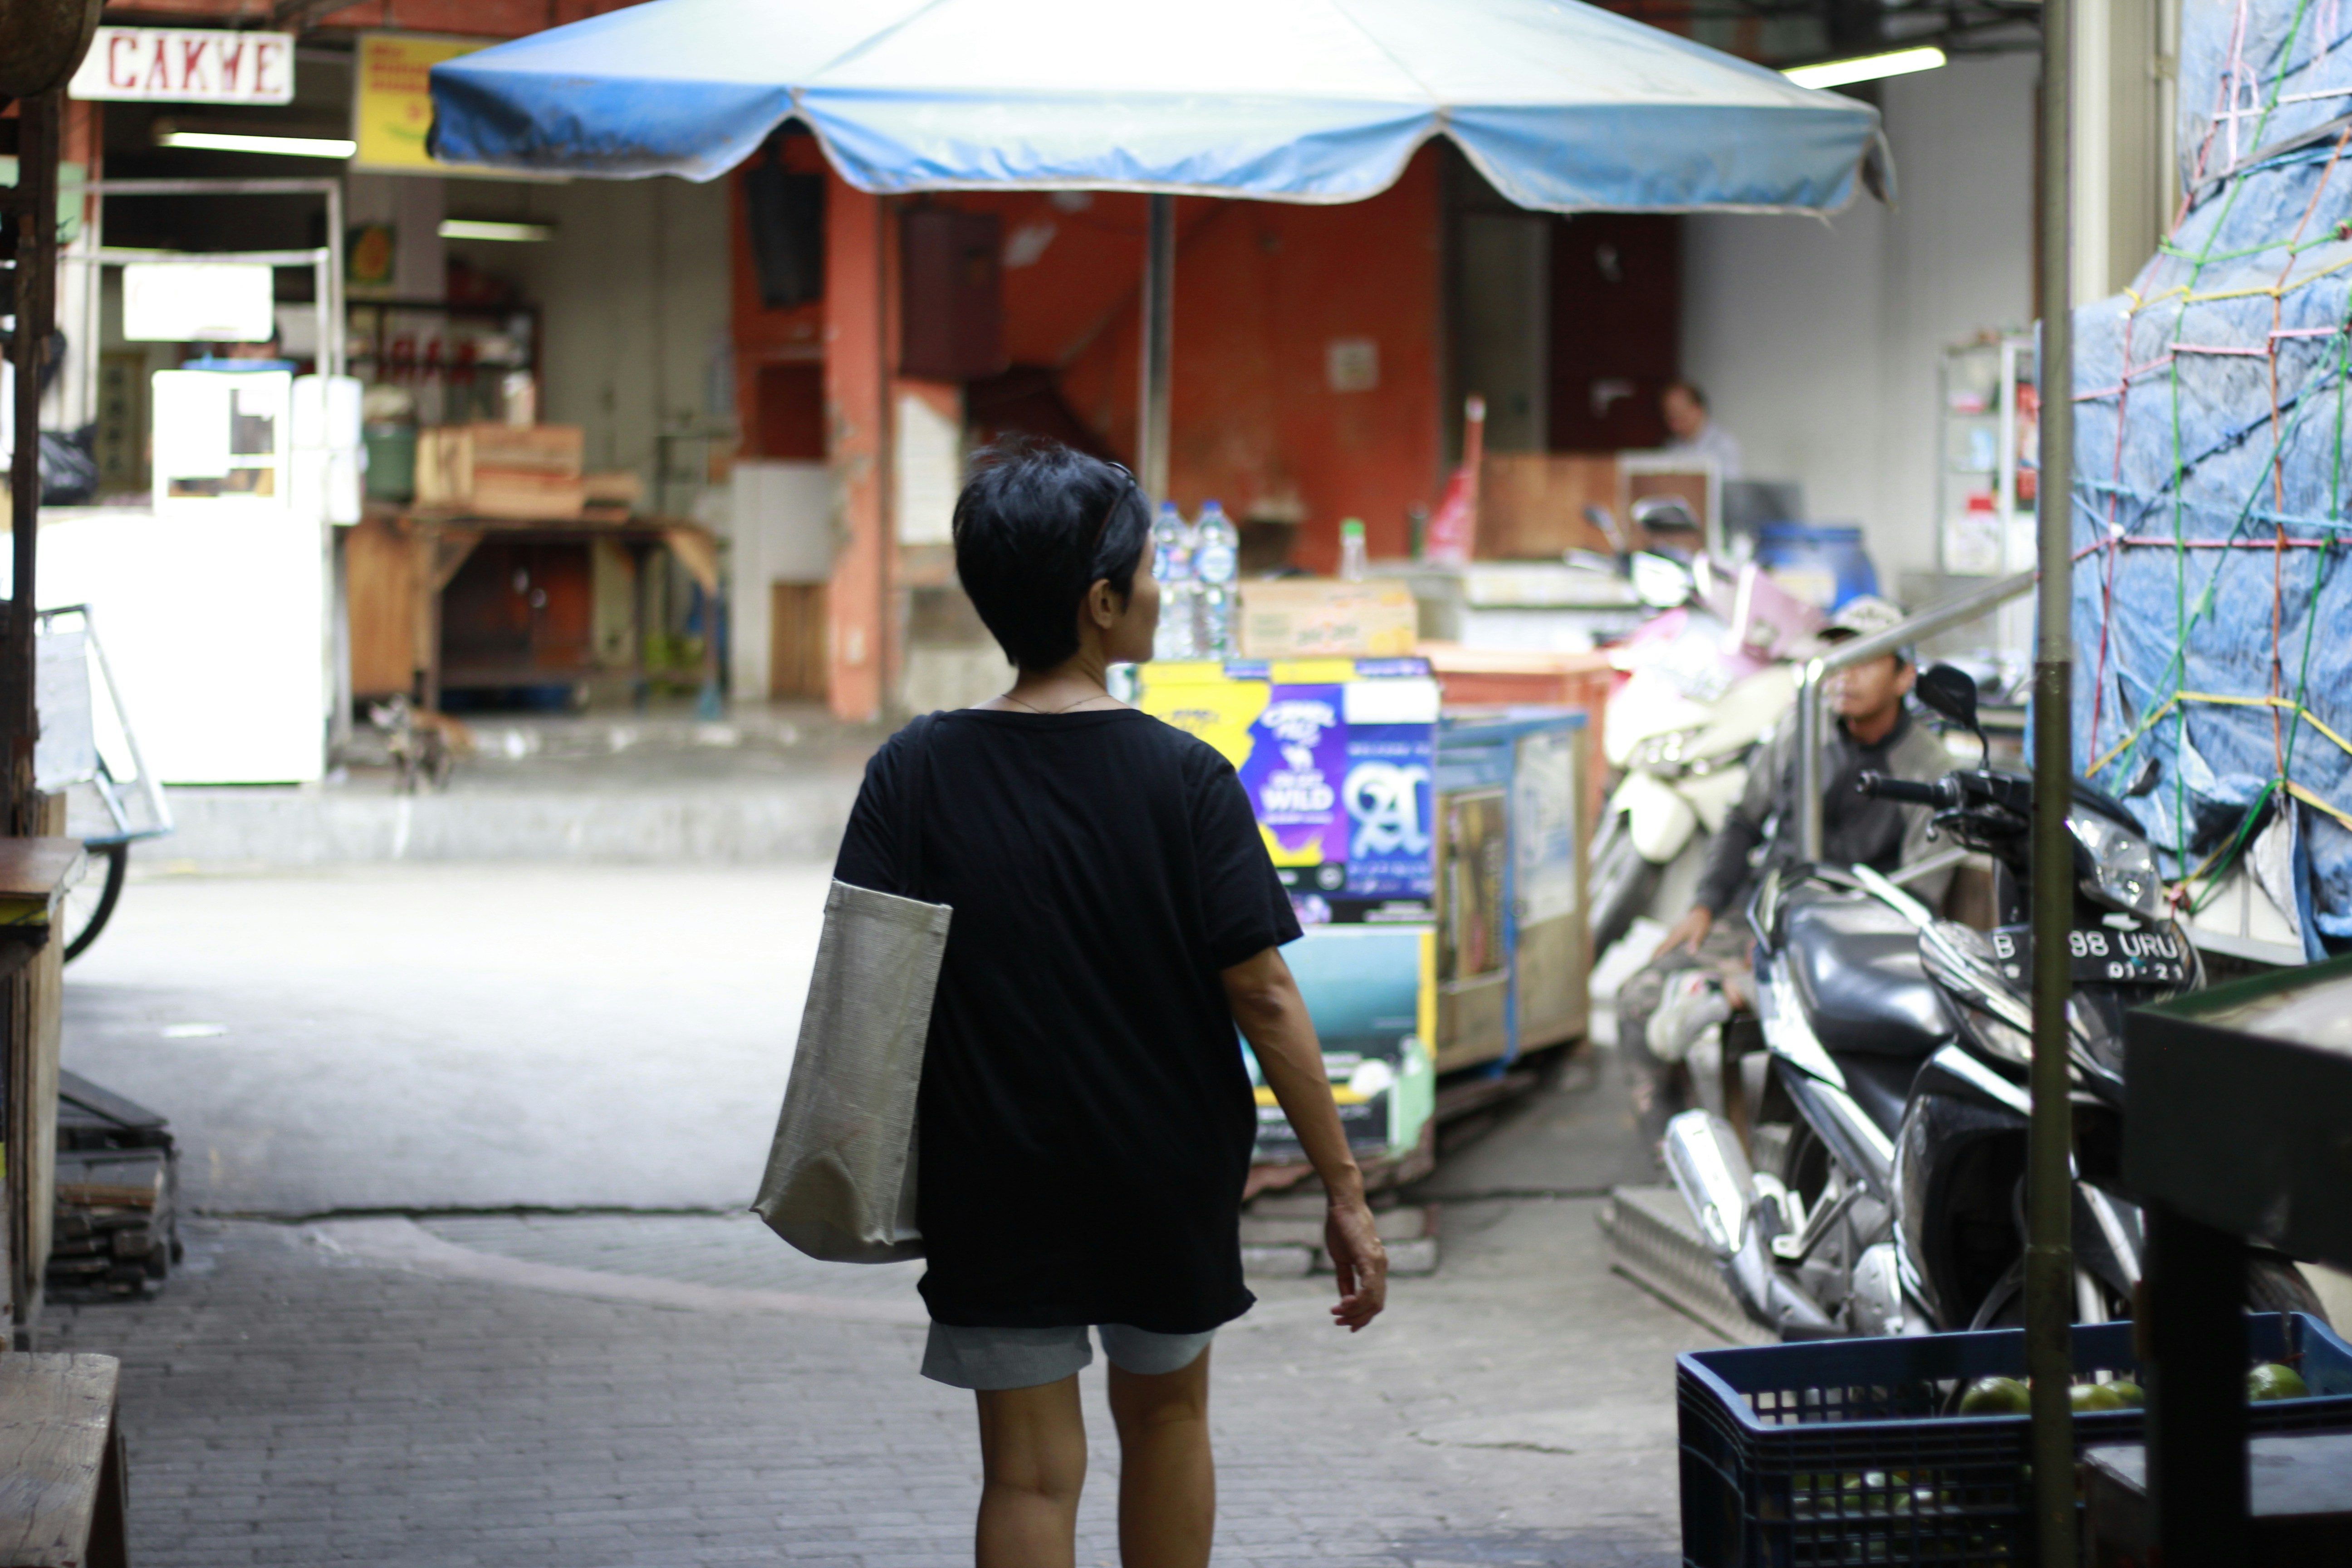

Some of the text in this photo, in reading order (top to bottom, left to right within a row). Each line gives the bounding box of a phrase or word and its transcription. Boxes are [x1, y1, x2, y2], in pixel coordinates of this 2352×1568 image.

[108, 35, 281, 93] CAKWE
[1261, 786, 1334, 811] WILD
[1993, 933, 2015, 959] B
[2117, 931, 2178, 959] URU
